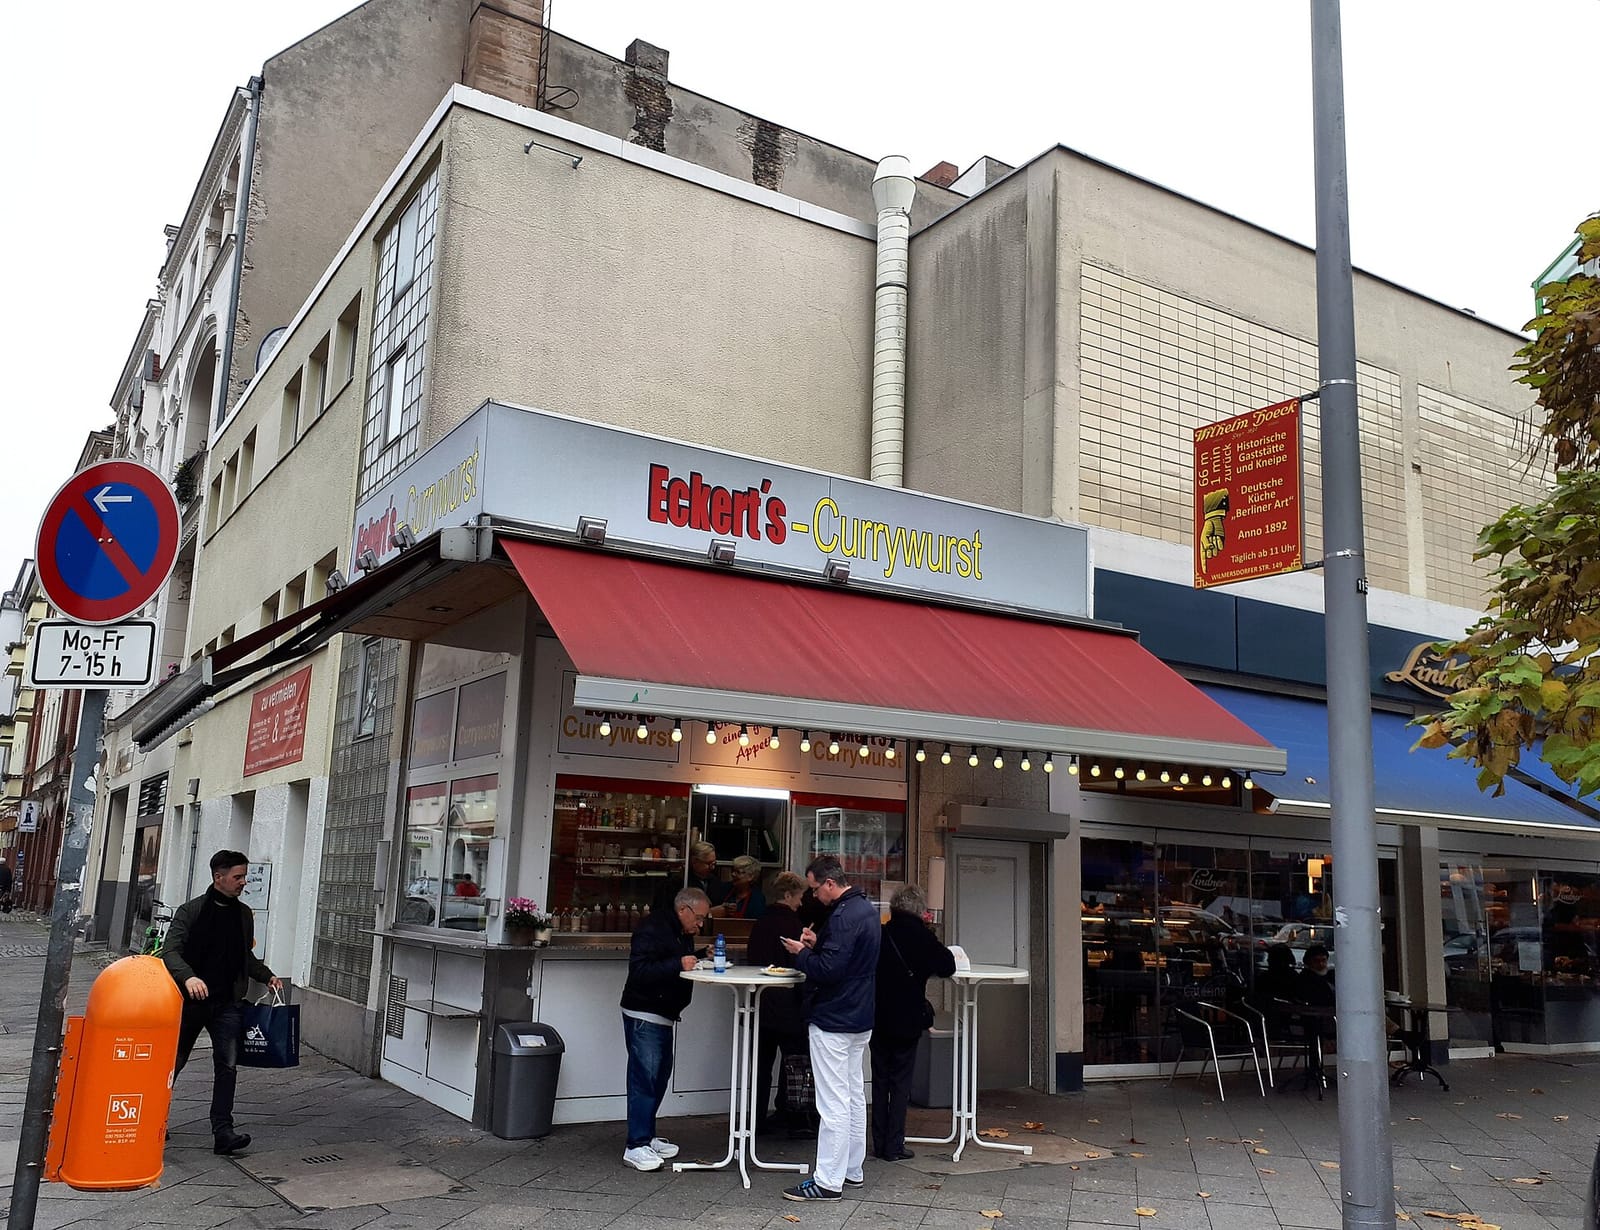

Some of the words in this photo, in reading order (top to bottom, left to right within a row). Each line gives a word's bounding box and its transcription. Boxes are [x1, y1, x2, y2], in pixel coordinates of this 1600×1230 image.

[1194, 418, 1249, 442] Wilhelm
[1236, 431, 1287, 452] Historische
[1200, 451, 1209, 466] m
[1210, 446, 1221, 473] min
[1222, 442, 1232, 482] zurück
[1238, 443, 1285, 462] Gaststätte
[1236, 463, 1254, 474] und
[1256, 454, 1288, 469] Kneipe
[1198, 469, 1209, 487] 66
[1210, 477, 1221, 486] 1
[1240, 477, 1284, 495] Deutsche
[1248, 490, 1276, 504] Küche
[1237, 527, 1262, 540] Anno
[1264, 520, 1288, 534] 1892
[1231, 551, 1257, 564] Täglich
[1258, 549, 1268, 558] ab
[1270, 547, 1279, 555] 11
[1280, 543, 1297, 553] Uhr
[1211, 566, 1258, 580] WILMERSDORFER
[62, 630, 125, 650] Mo-Fr
[111, 656, 121, 676] h
[268, 682, 297, 707] vermieten
[111, 1100, 138, 1119] BSR
